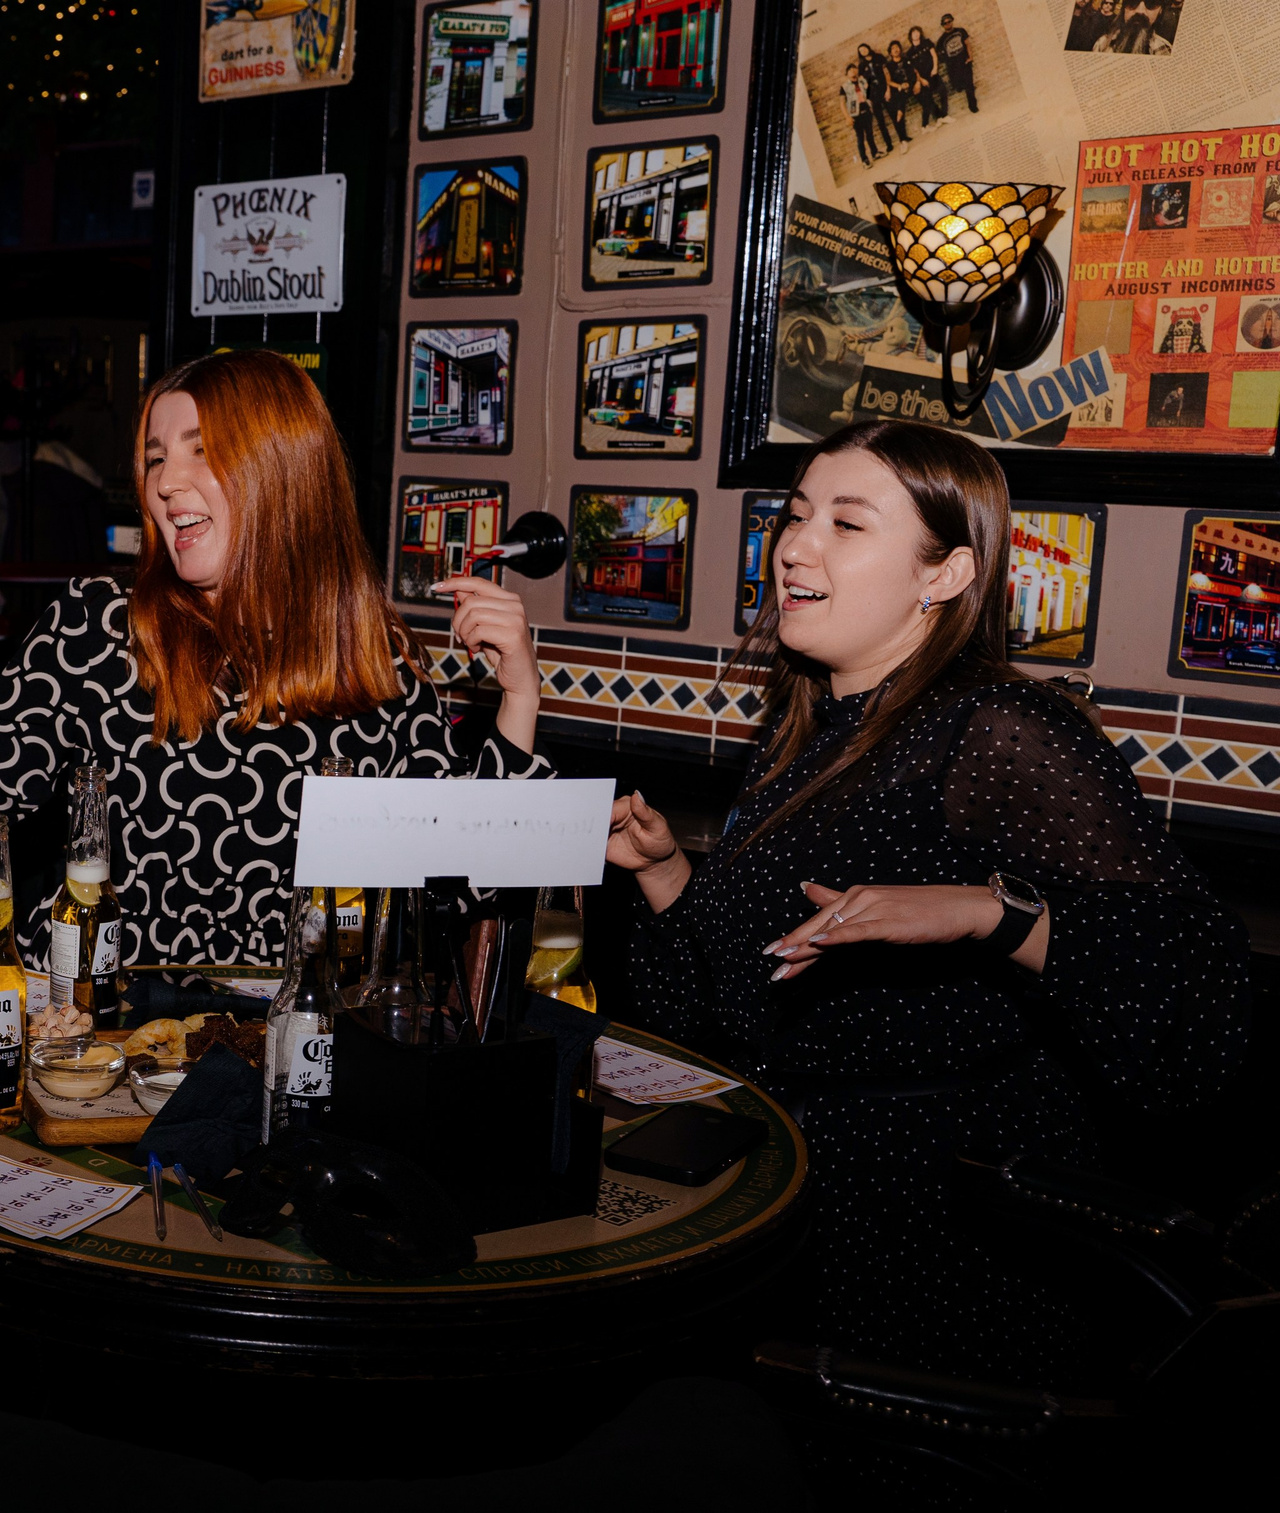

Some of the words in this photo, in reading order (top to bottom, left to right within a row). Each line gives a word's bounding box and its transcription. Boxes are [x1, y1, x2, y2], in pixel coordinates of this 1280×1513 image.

[221, 49, 244, 62] dart
[247, 46, 263, 58] for
[266, 46, 274, 55] a
[208, 60, 286, 87] GUINNESS
[1084, 143, 1144, 171] HOT
[1160, 137, 1223, 165] HOT
[1239, 132, 1280, 159] HO
[1088, 171, 1122, 185] JULY
[1132, 165, 1205, 182] RELEASES
[1213, 161, 1257, 176] FROM
[794, 210, 818, 230] YOUR
[819, 221, 859, 245] DRIVING
[787, 224, 798, 236] IS
[797, 228, 805, 239] A
[805, 231, 842, 254] MATTER
[842, 246, 857, 258] OF
[1074, 261, 1150, 282] HOTTER
[1161, 258, 1204, 279] AND
[1214, 255, 1280, 276] HOTTE
[203, 269, 266, 305] Dublin
[267, 265, 326, 301] Stout
[1105, 282, 1172, 297] AUGUST
[1181, 278, 1276, 294] INCOMINGS
[861, 380, 898, 413] be
[468, 487, 489, 498] PUB
[291, 1099, 300, 1108] 330
[51, 1177, 73, 1187] 22
[93, 1186, 115, 1195] 29
[66, 1203, 85, 1212] 19
[32, 1218, 56, 1227] 33
[62, 1235, 173, 1267] АРМЕНА
[458, 1258, 571, 1281] СПРОСИ
[571, 1232, 685, 1267] ШАХМАТЫ
[701, 1196, 759, 1230] ШАШКИ
[225, 1261, 396, 1283] HARATS.
